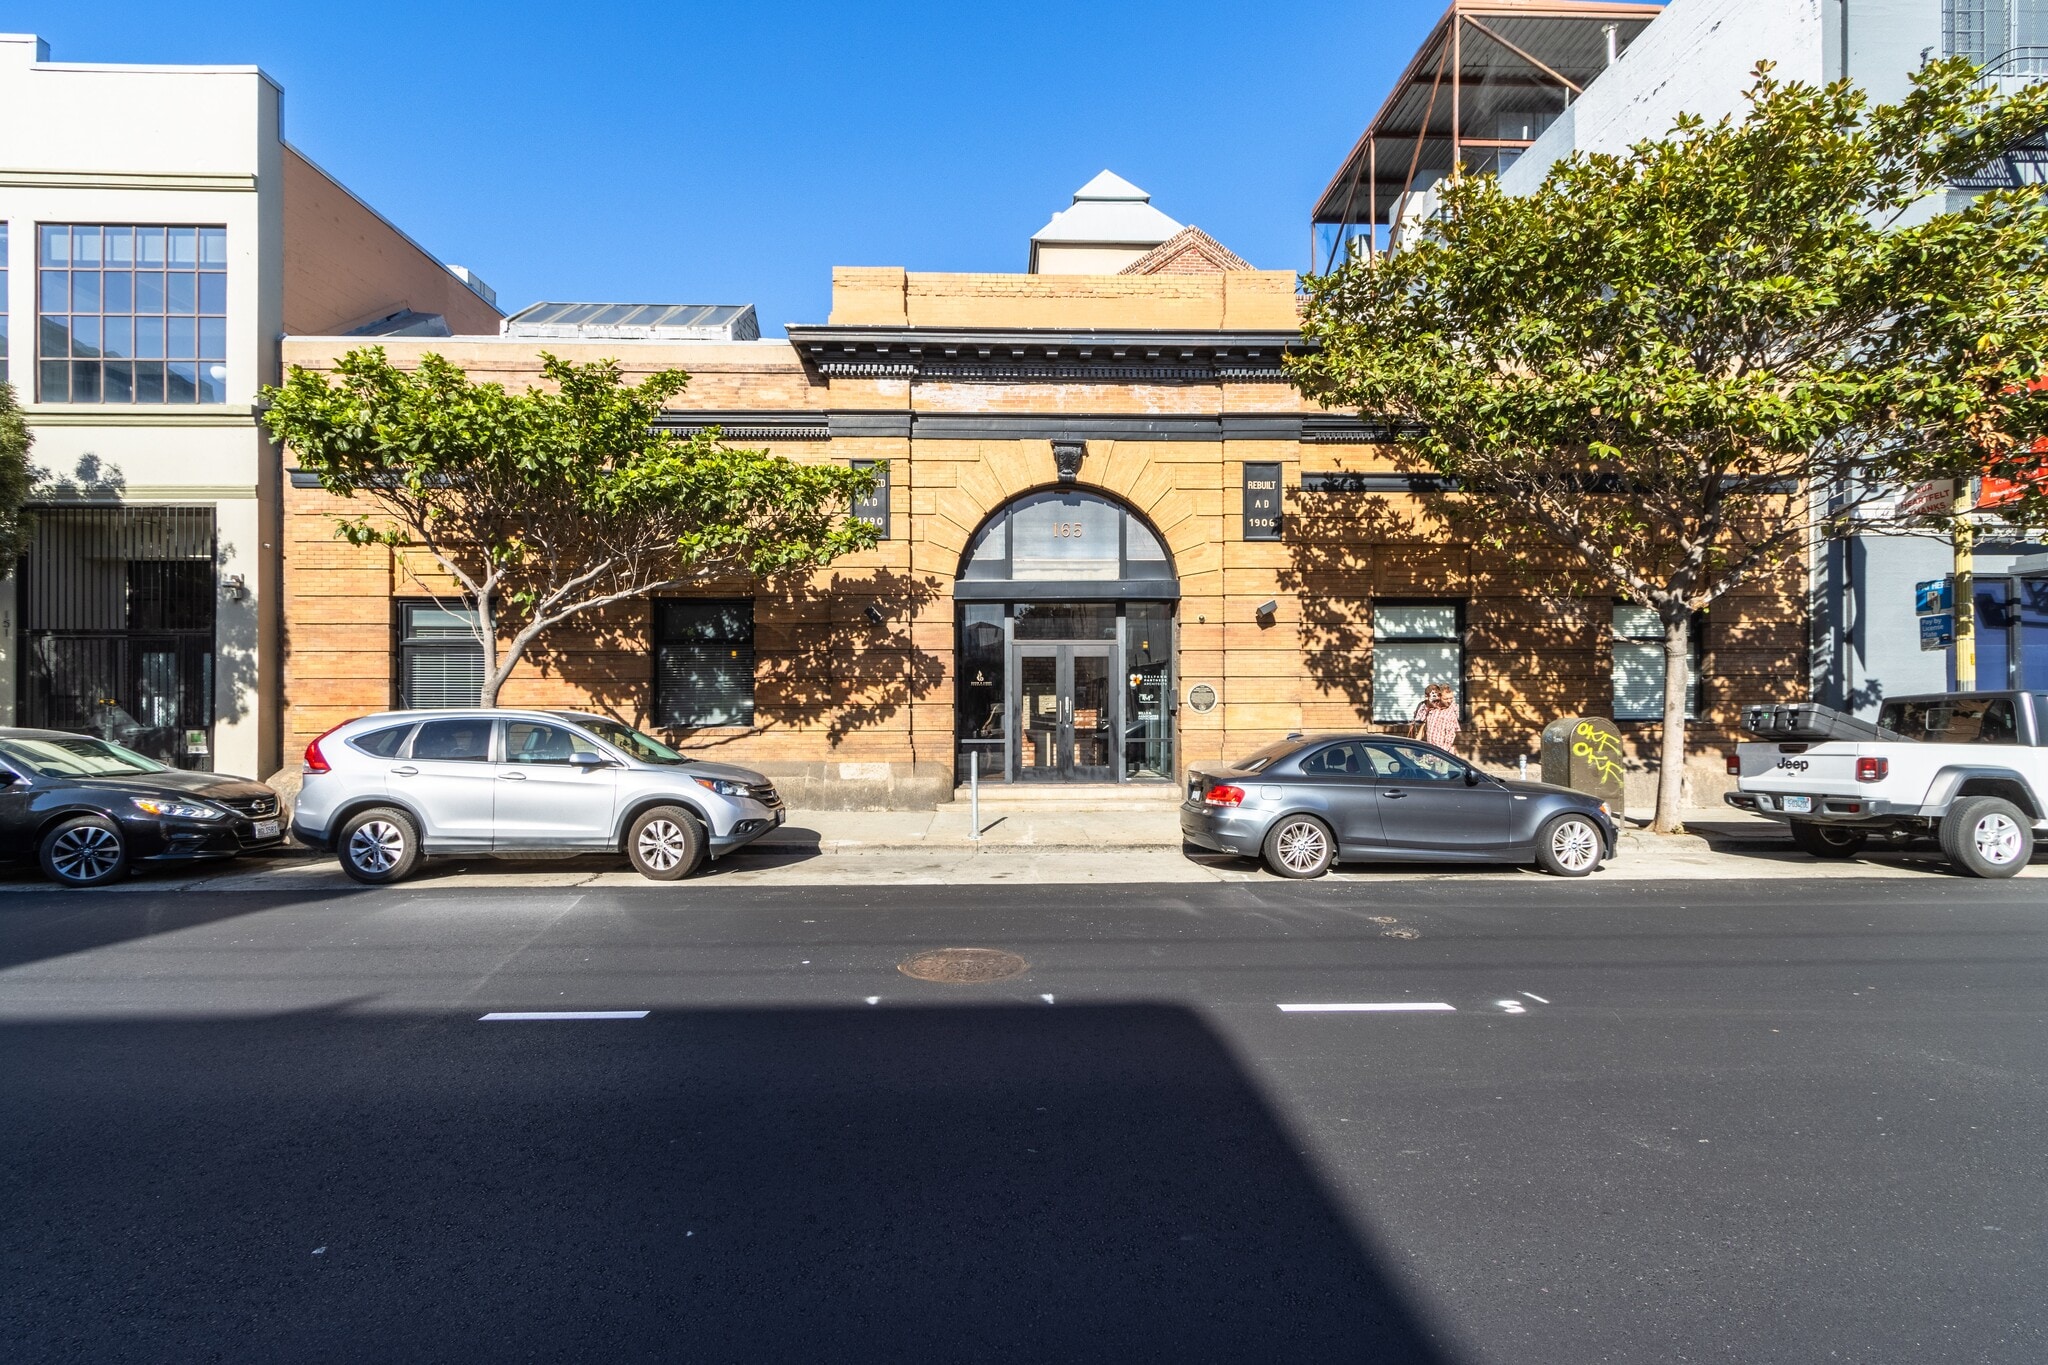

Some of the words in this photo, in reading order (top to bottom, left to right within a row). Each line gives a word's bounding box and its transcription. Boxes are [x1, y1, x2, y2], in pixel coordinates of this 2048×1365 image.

[1247, 480, 1277, 490] REBUILT
[1914, 483, 1933, 495] OUR
[1900, 489, 1950, 509] HEARTFELT
[857, 517, 884, 526] 1890
[1249, 518, 1275, 527] 1906
[1052, 522, 1083, 538] 165
[1932, 580, 1951, 590] HERE
[1776, 757, 1809, 772] Jeep
